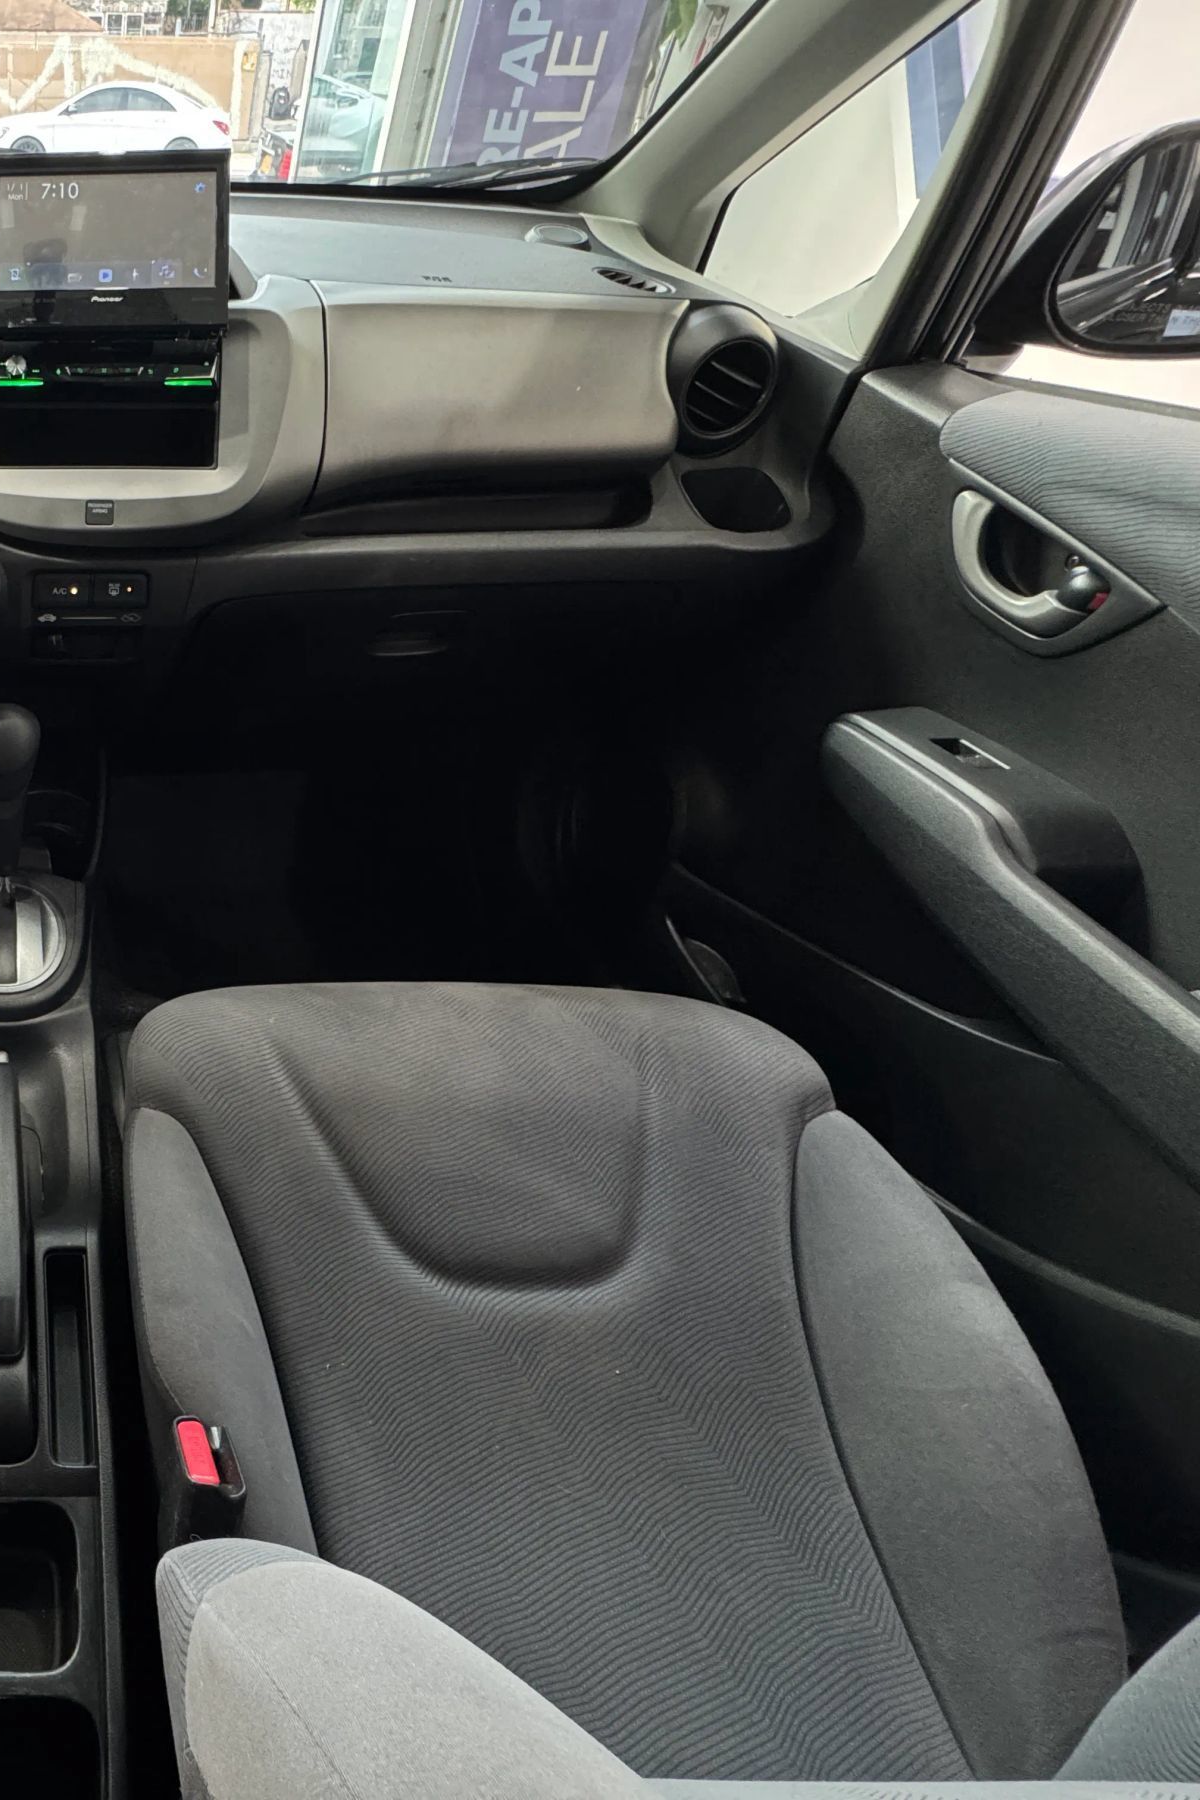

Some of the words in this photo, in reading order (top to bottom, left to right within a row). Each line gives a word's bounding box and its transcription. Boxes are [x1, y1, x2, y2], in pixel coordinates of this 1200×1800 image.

[41, 182, 79, 200] 7:10
[8, 193, 24, 201] Mon
[90, 295, 125, 304] Pioneer
[52, 587, 68, 596] A/C
